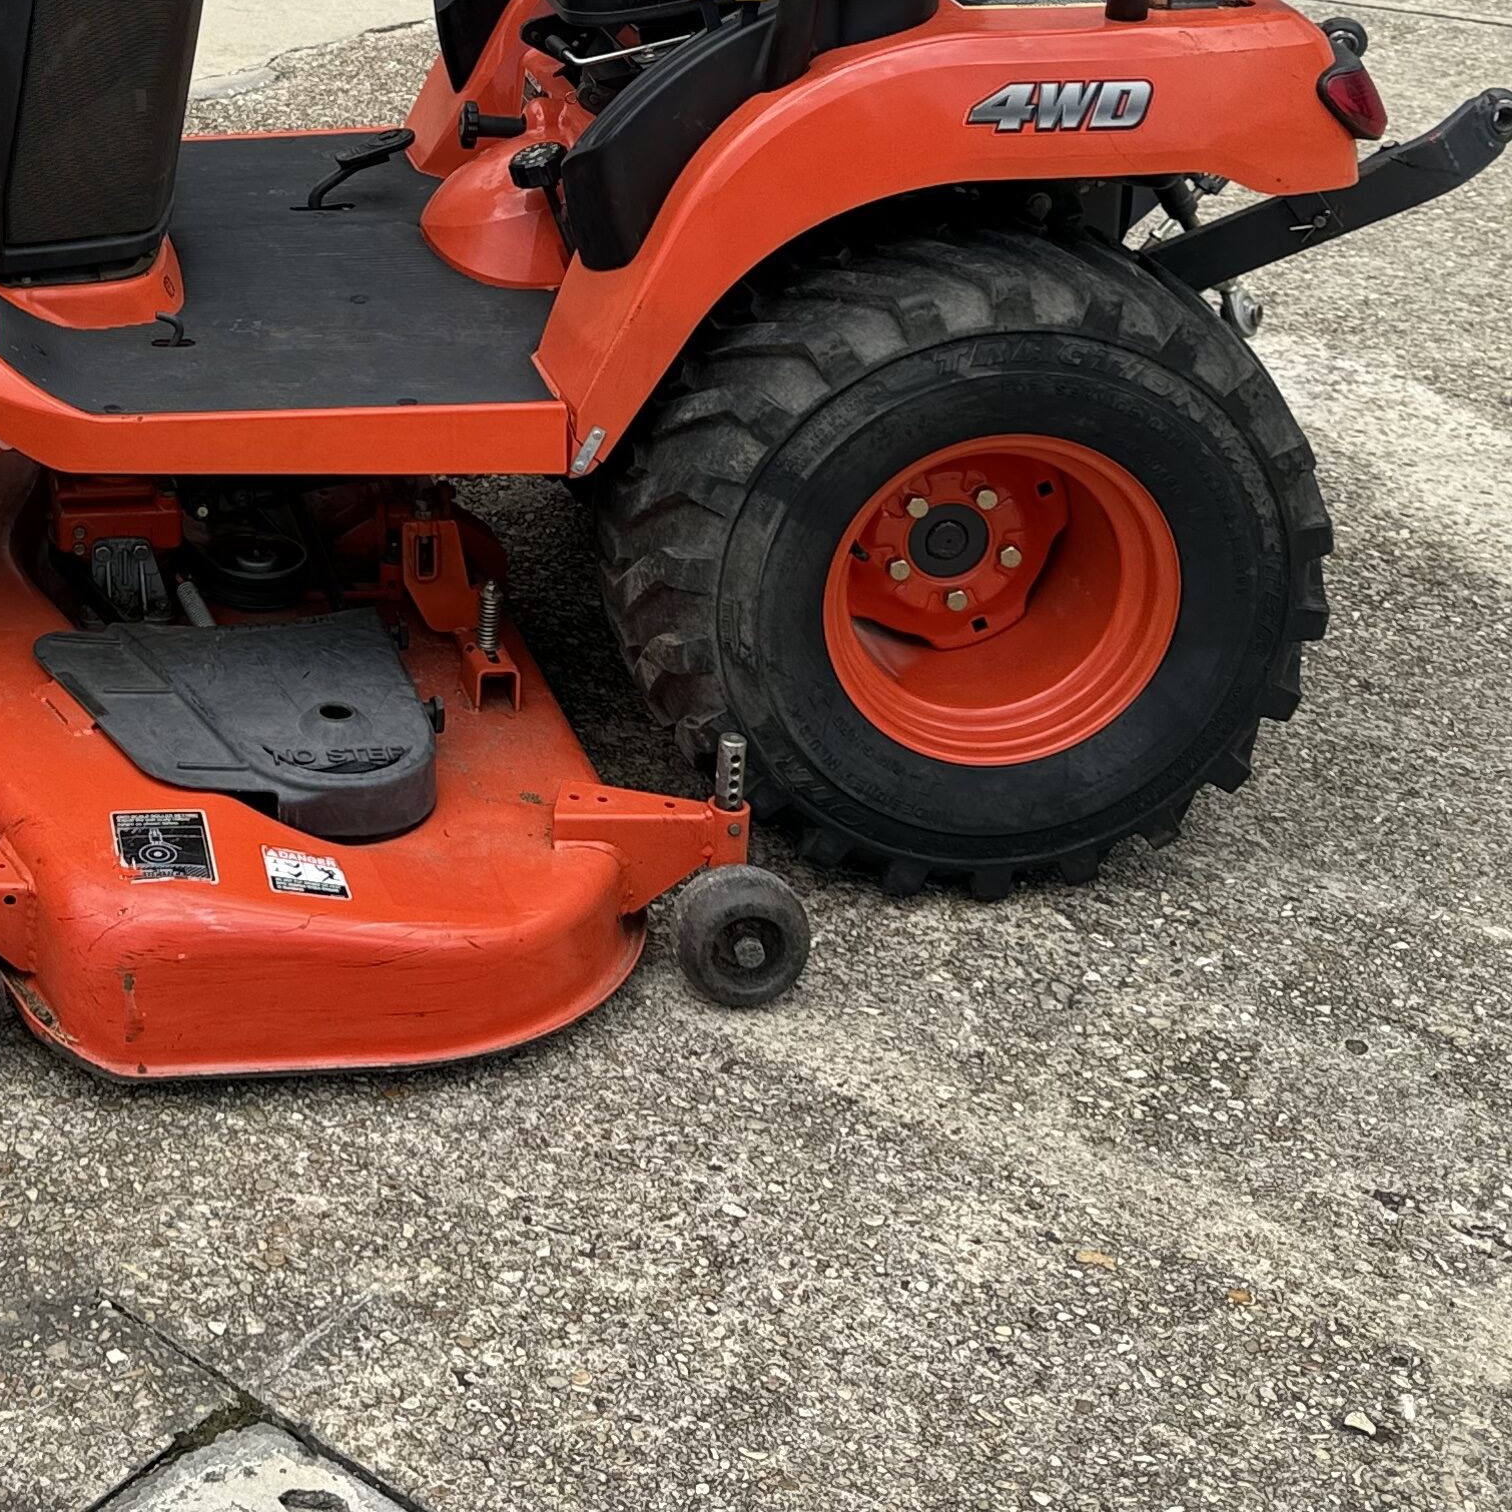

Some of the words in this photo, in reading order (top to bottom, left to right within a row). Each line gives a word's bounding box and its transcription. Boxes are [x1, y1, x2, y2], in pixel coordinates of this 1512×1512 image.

[967, 79, 1154, 133] 4WD
[932, 337, 1212, 428] TRACTION
[271, 748, 317, 766] NO
[326, 745, 411, 765] STEP
